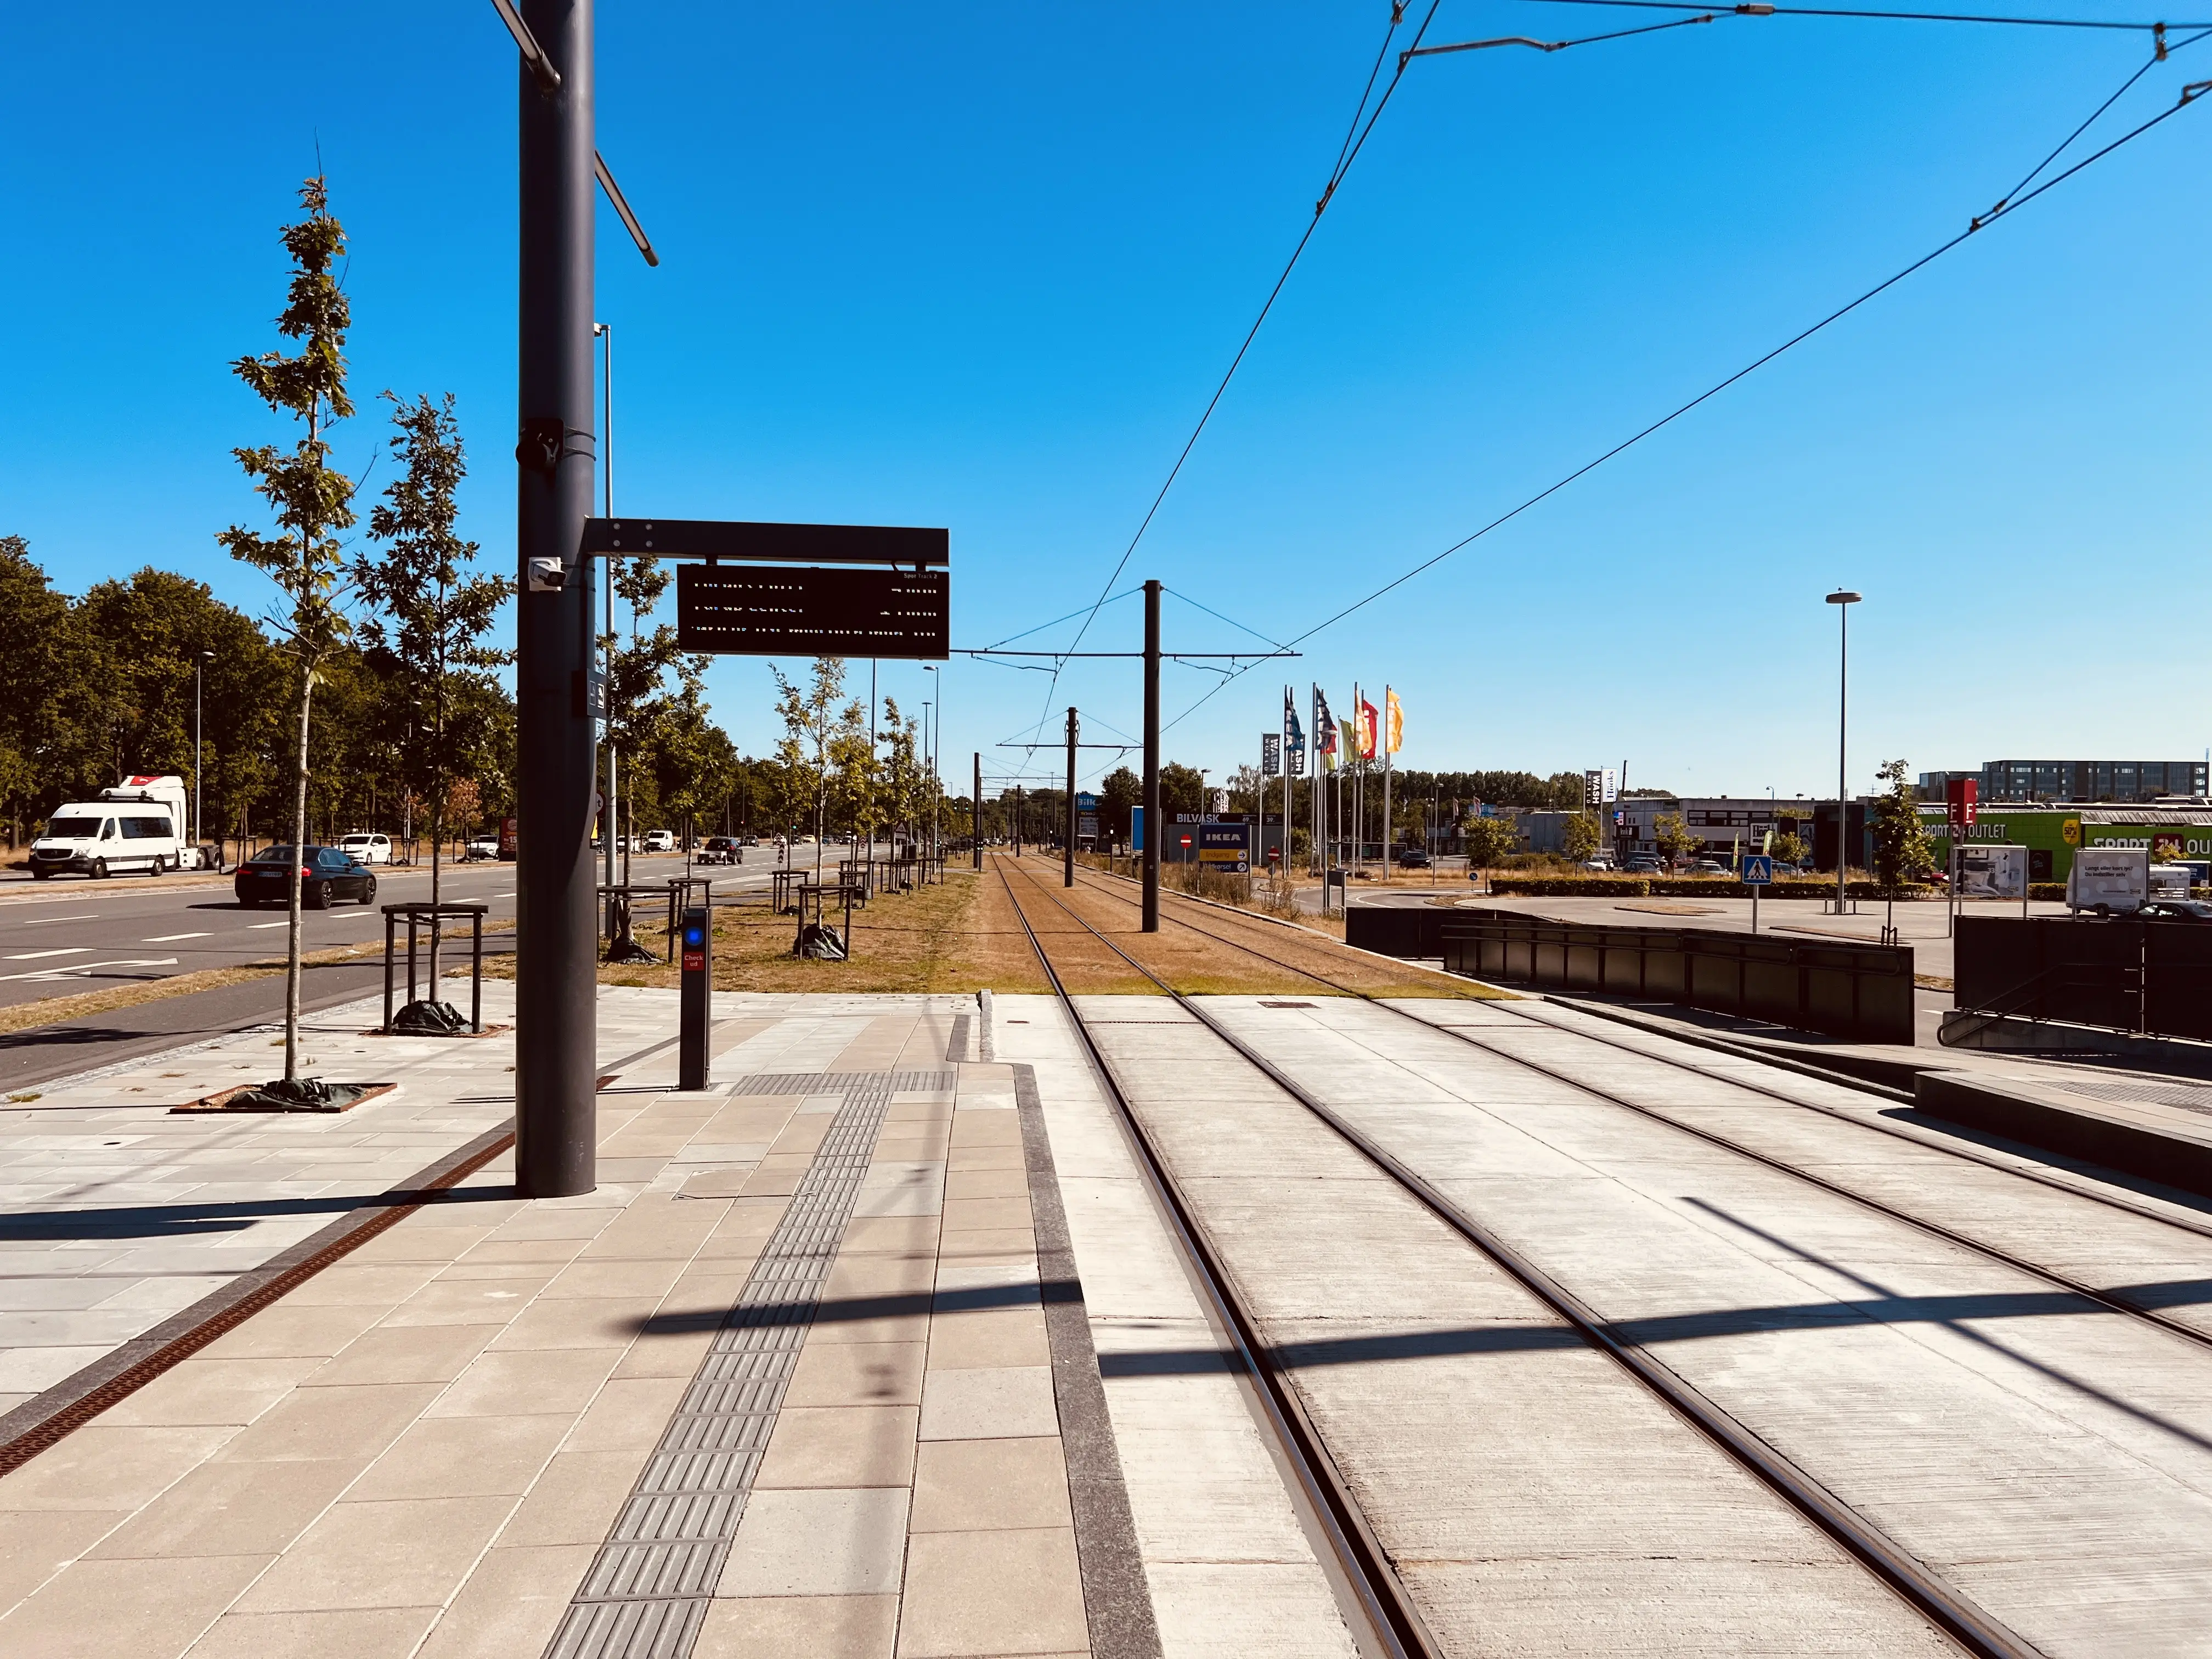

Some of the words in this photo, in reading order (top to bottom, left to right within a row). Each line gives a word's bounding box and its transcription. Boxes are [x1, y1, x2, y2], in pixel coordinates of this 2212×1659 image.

[1270, 738, 1278, 771] WASH
[1592, 775, 1600, 804] WASH
[1177, 814, 1220, 823] BILVASK
[1950, 803, 1957, 820] F
[1966, 803, 1973, 820] F
[1968, 825, 2006, 838] OUTLET
[2187, 839, 2212, 855] OU
